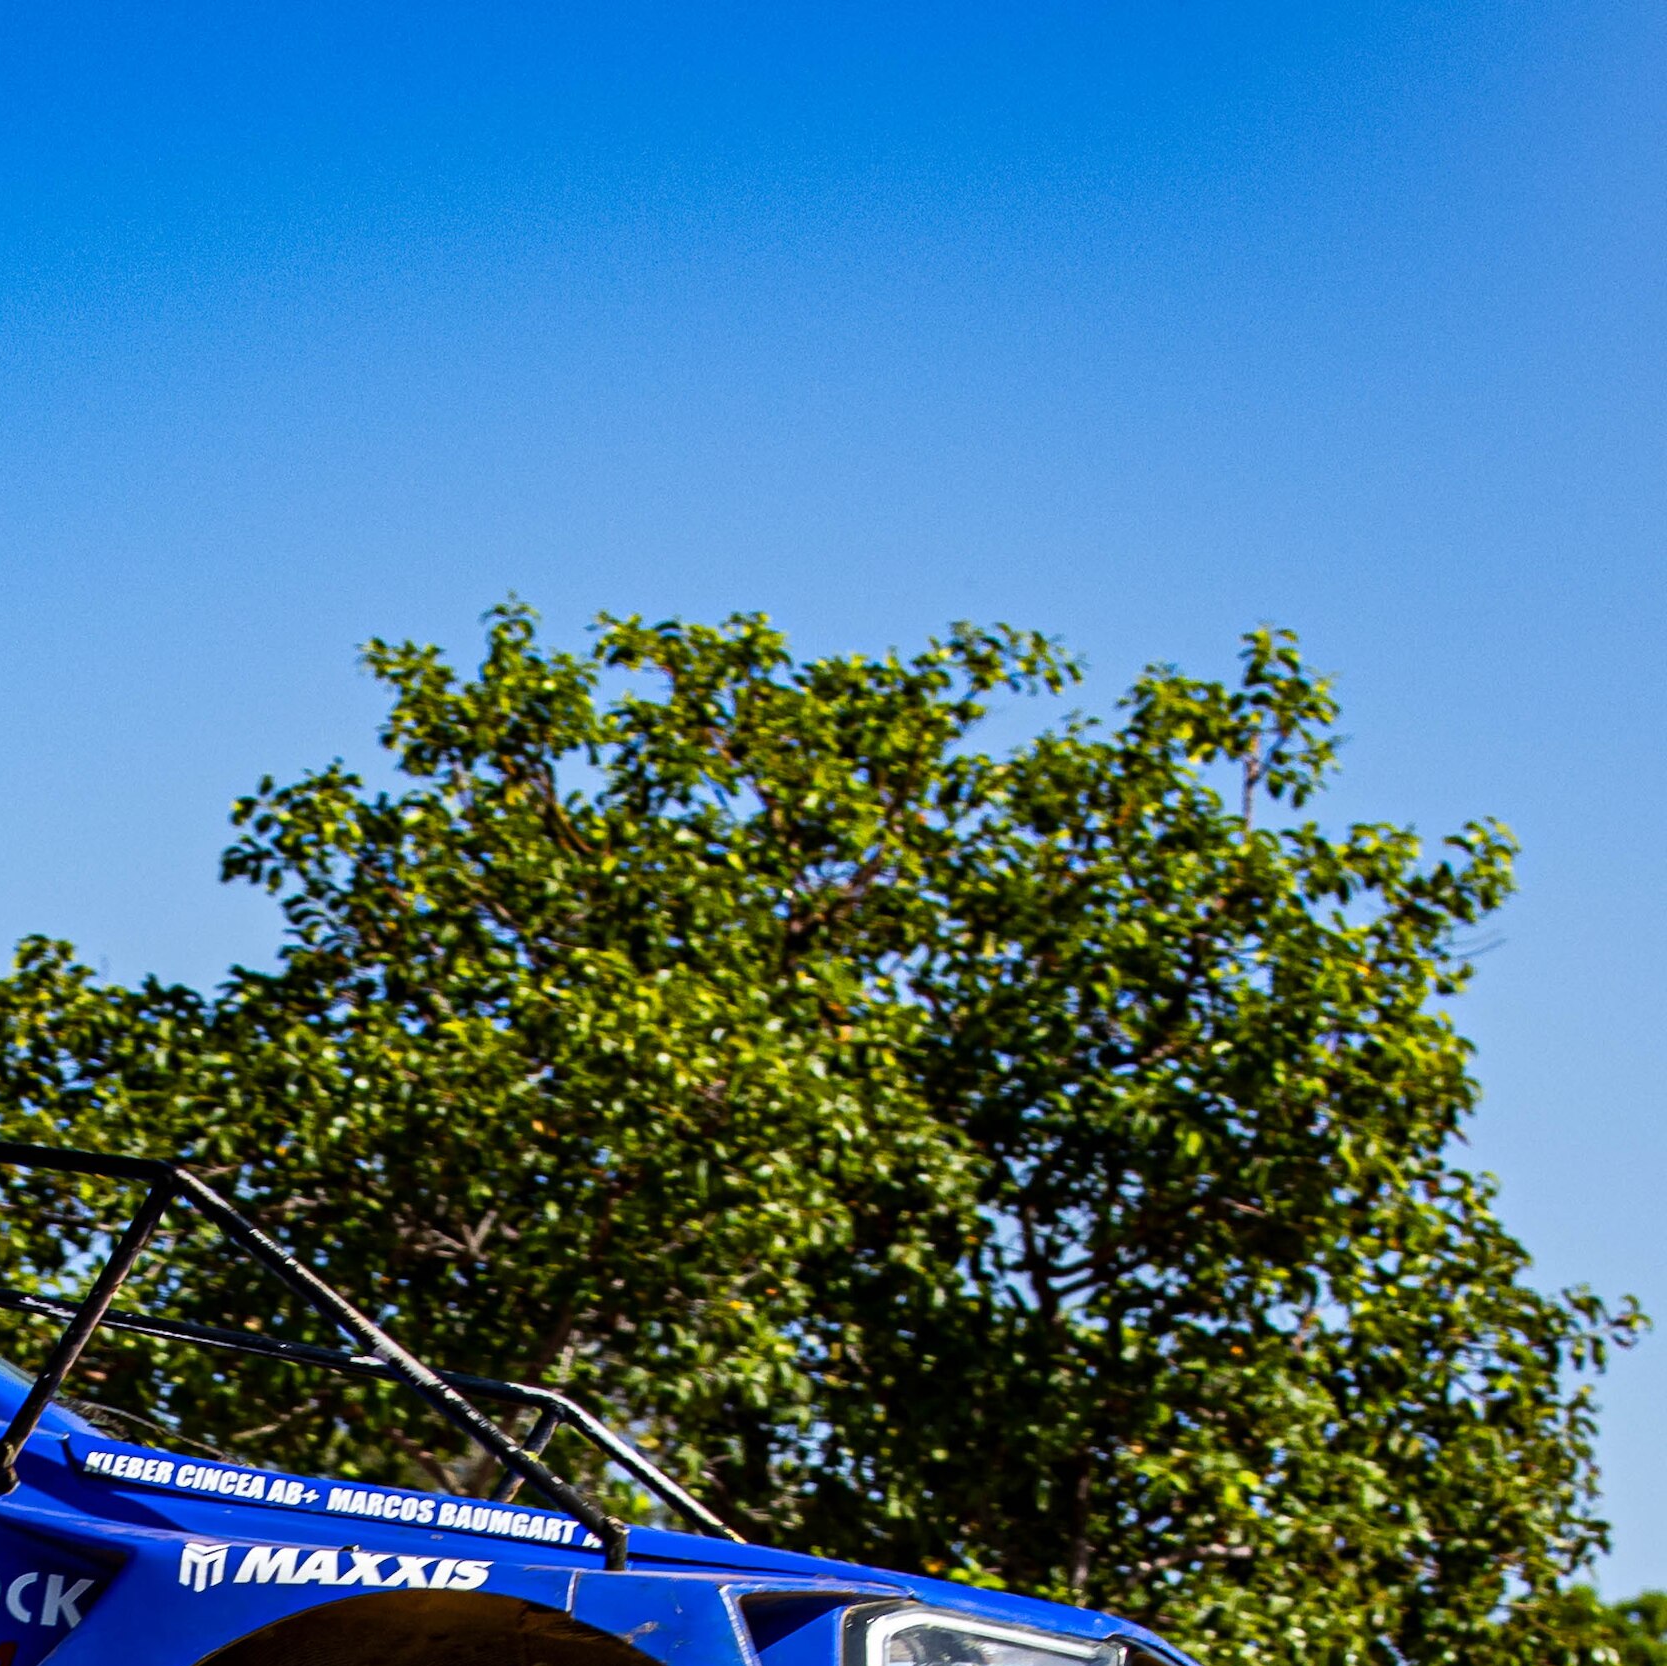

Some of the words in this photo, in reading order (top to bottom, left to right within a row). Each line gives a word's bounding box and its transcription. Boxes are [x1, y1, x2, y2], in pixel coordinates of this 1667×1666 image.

[83, 1451, 175, 1484] KLEBER
[175, 1464, 267, 1499] CINCEA
[265, 1478, 320, 1506] AB+
[325, 1486, 436, 1524] MARCOS
[436, 1502, 581, 1544] BAUMGART
[233, 1546, 495, 1590] MAXXIS
